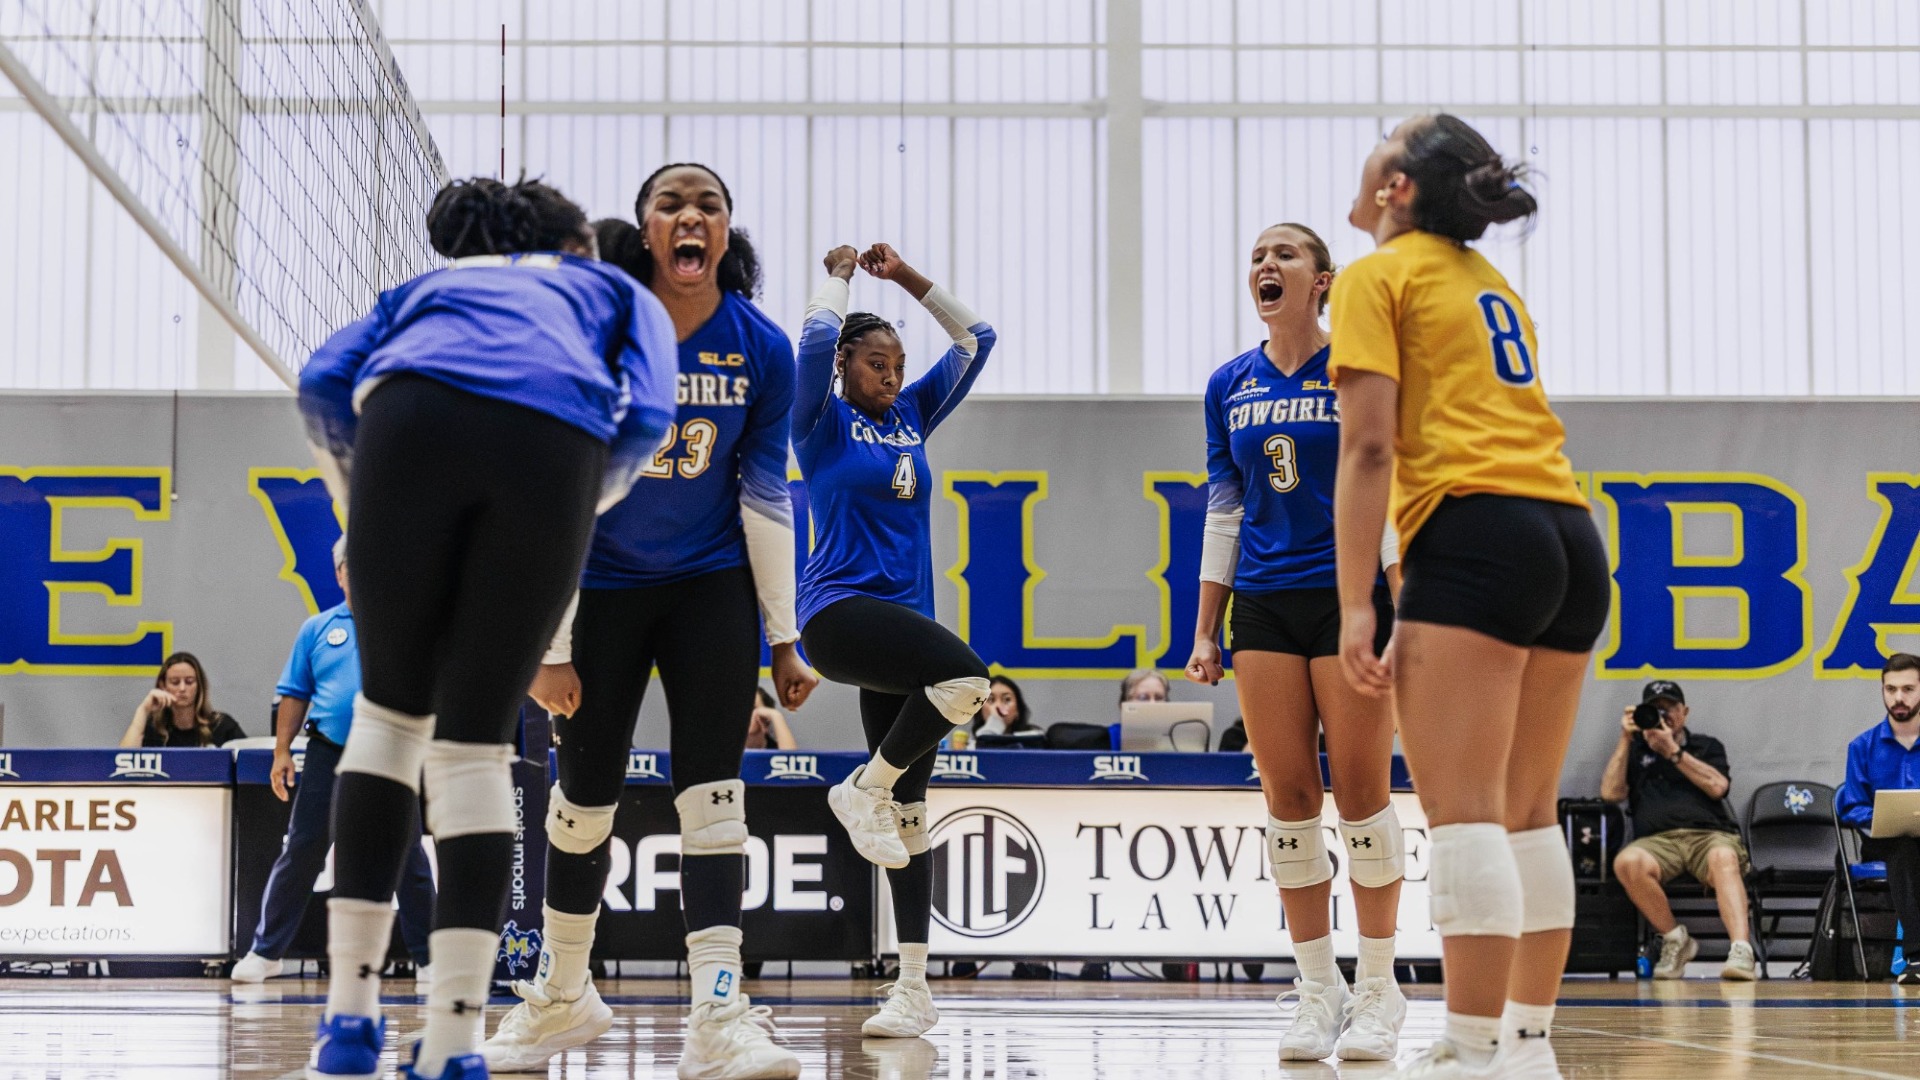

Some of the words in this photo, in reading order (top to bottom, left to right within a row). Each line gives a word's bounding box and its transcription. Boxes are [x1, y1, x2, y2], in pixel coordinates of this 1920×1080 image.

[1476, 289, 1536, 387] 8
[640, 417, 718, 479] 23
[891, 452, 917, 499] 4
[1263, 433, 1300, 493] 3
[627, 754, 657, 774] ITI
[0, 799, 137, 831] ARLES
[511, 843, 527, 911] imports
